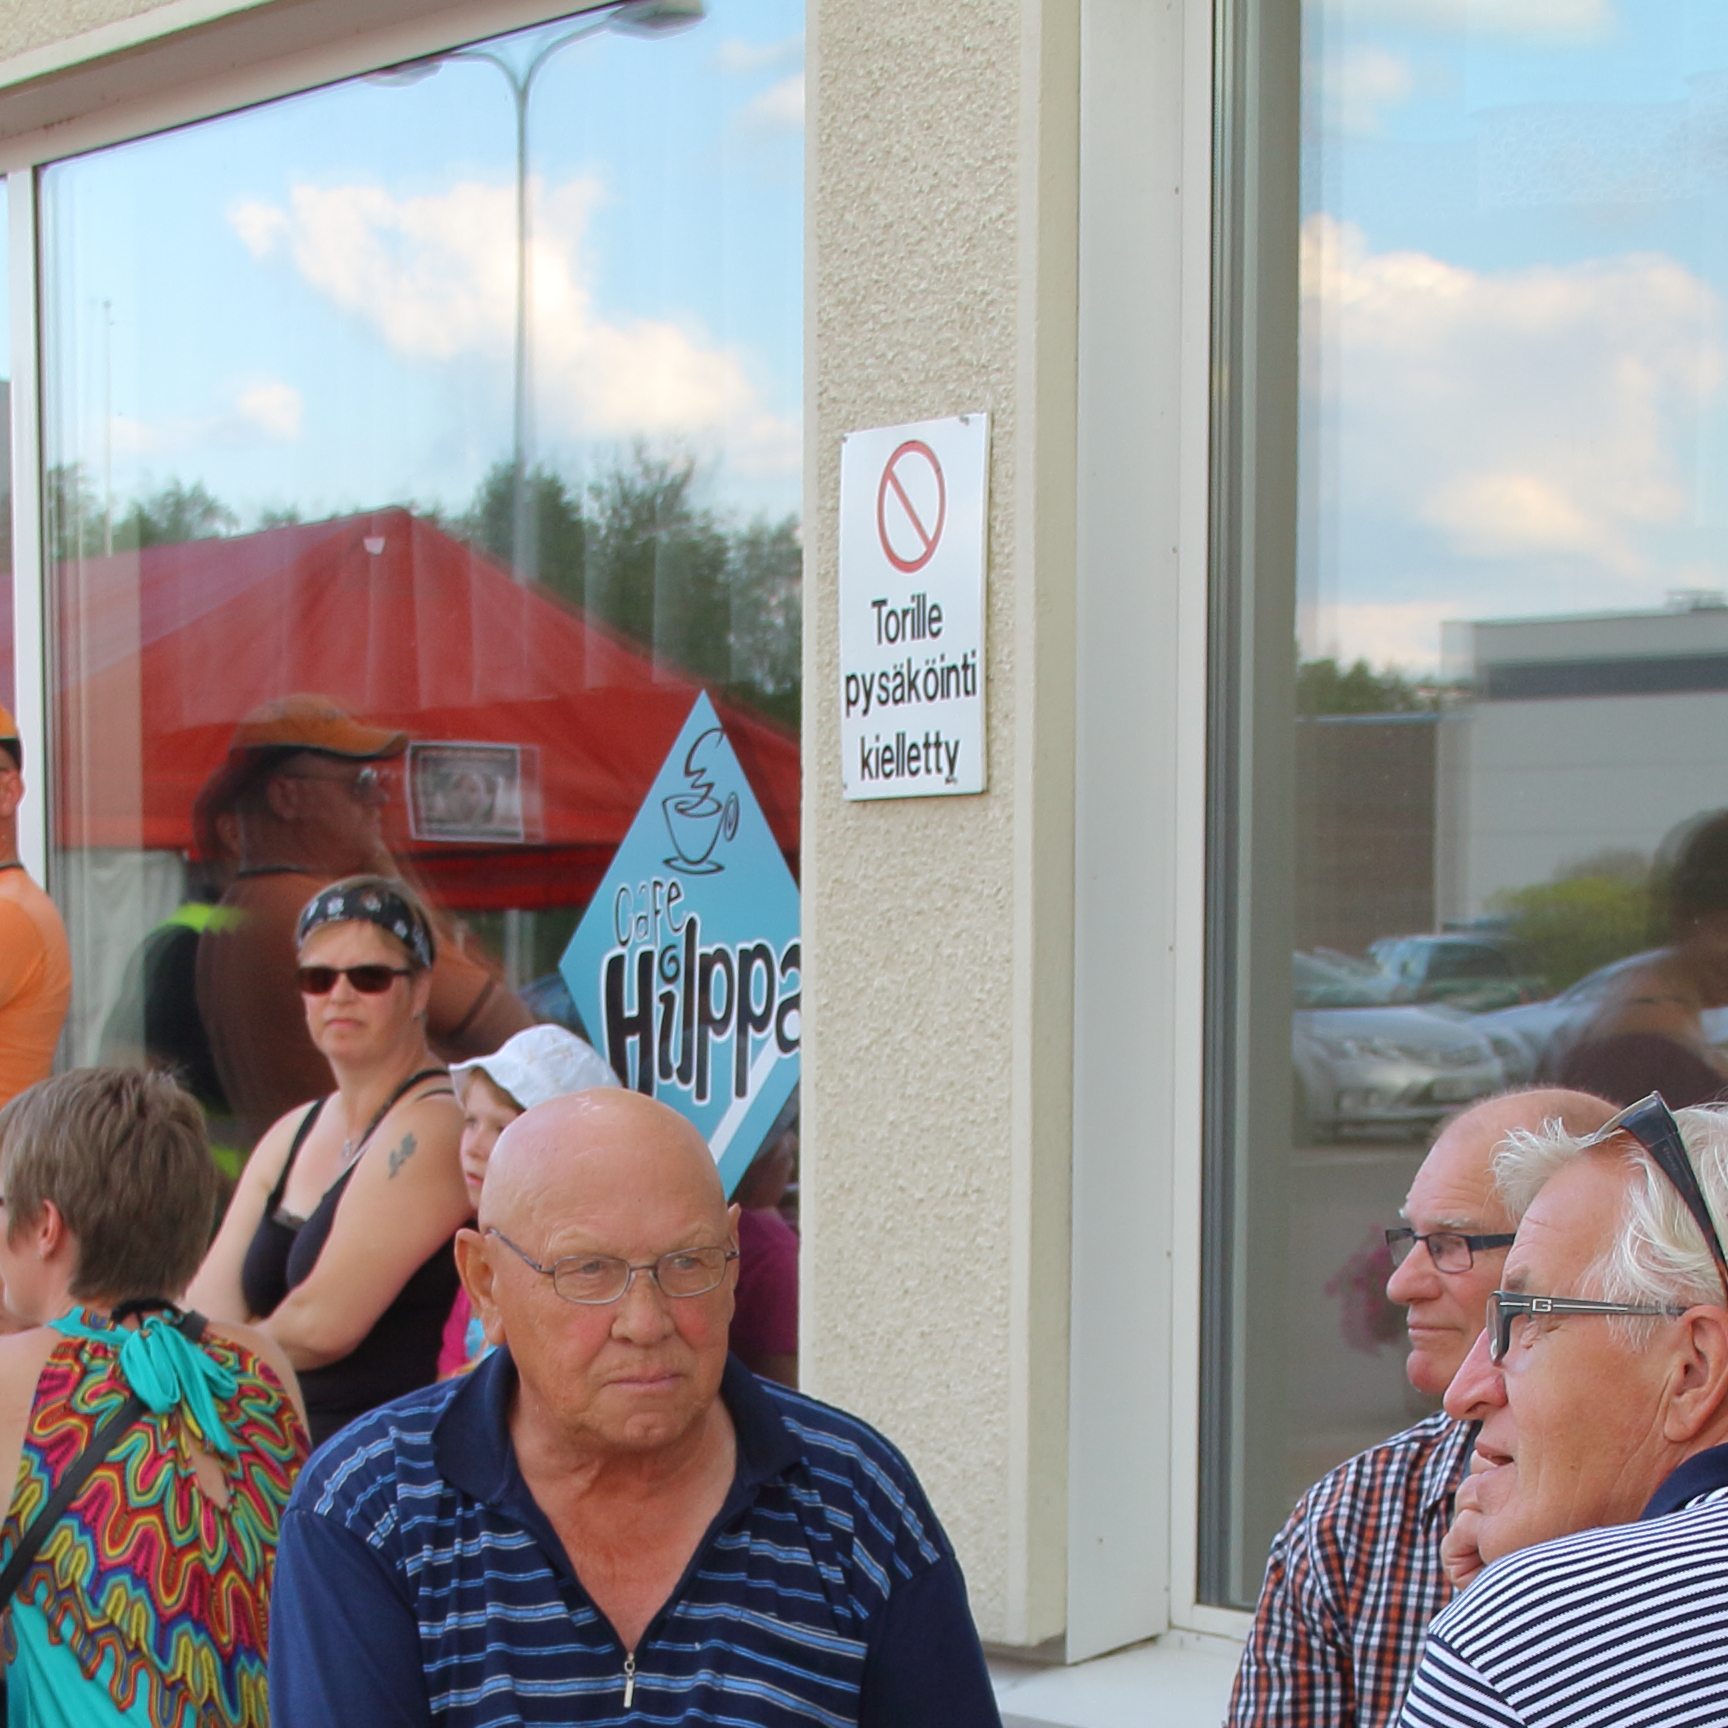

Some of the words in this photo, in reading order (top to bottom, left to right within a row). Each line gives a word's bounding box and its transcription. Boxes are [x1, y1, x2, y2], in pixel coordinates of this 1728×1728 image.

[872, 593, 943, 645] Torille
[845, 650, 977, 718] pysäköinti
[860, 730, 960, 785] kielletty
[606, 915, 802, 1102] Hilppa
